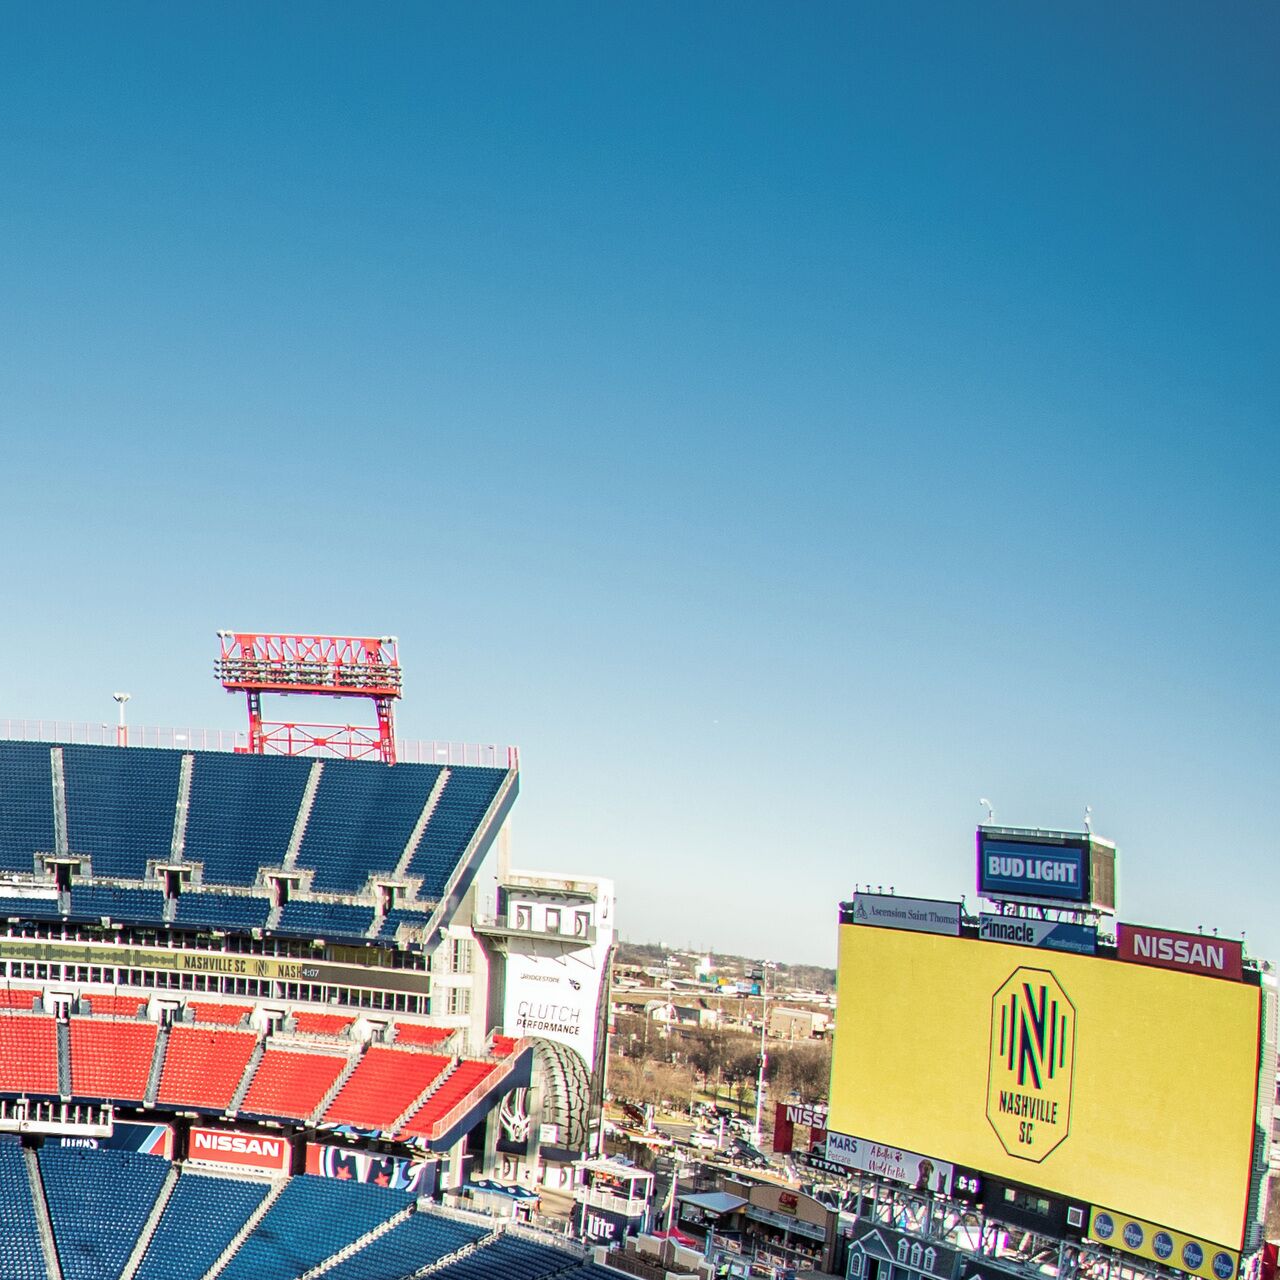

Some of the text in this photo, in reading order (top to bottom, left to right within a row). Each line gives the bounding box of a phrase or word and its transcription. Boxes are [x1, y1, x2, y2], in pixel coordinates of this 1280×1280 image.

[988, 856, 1077, 883] BUD LIGHT
[870, 906, 959, 925] Ascension Saint Thomas
[980, 917, 1034, 942] Pinnacle
[184, 955, 246, 973] NASHVILLE SC
[1134, 934, 1224, 970] NISSAN
[518, 1001, 580, 1023] CLUTCH
[516, 1019, 580, 1035] PERFORMANCE
[999, 1090, 1058, 1125] NASHVILLE
[829, 1135, 857, 1153] MARS
[1019, 1120, 1034, 1145] SC
[195, 1133, 279, 1157] NISSAN
[588, 1214, 615, 1239] Lite
